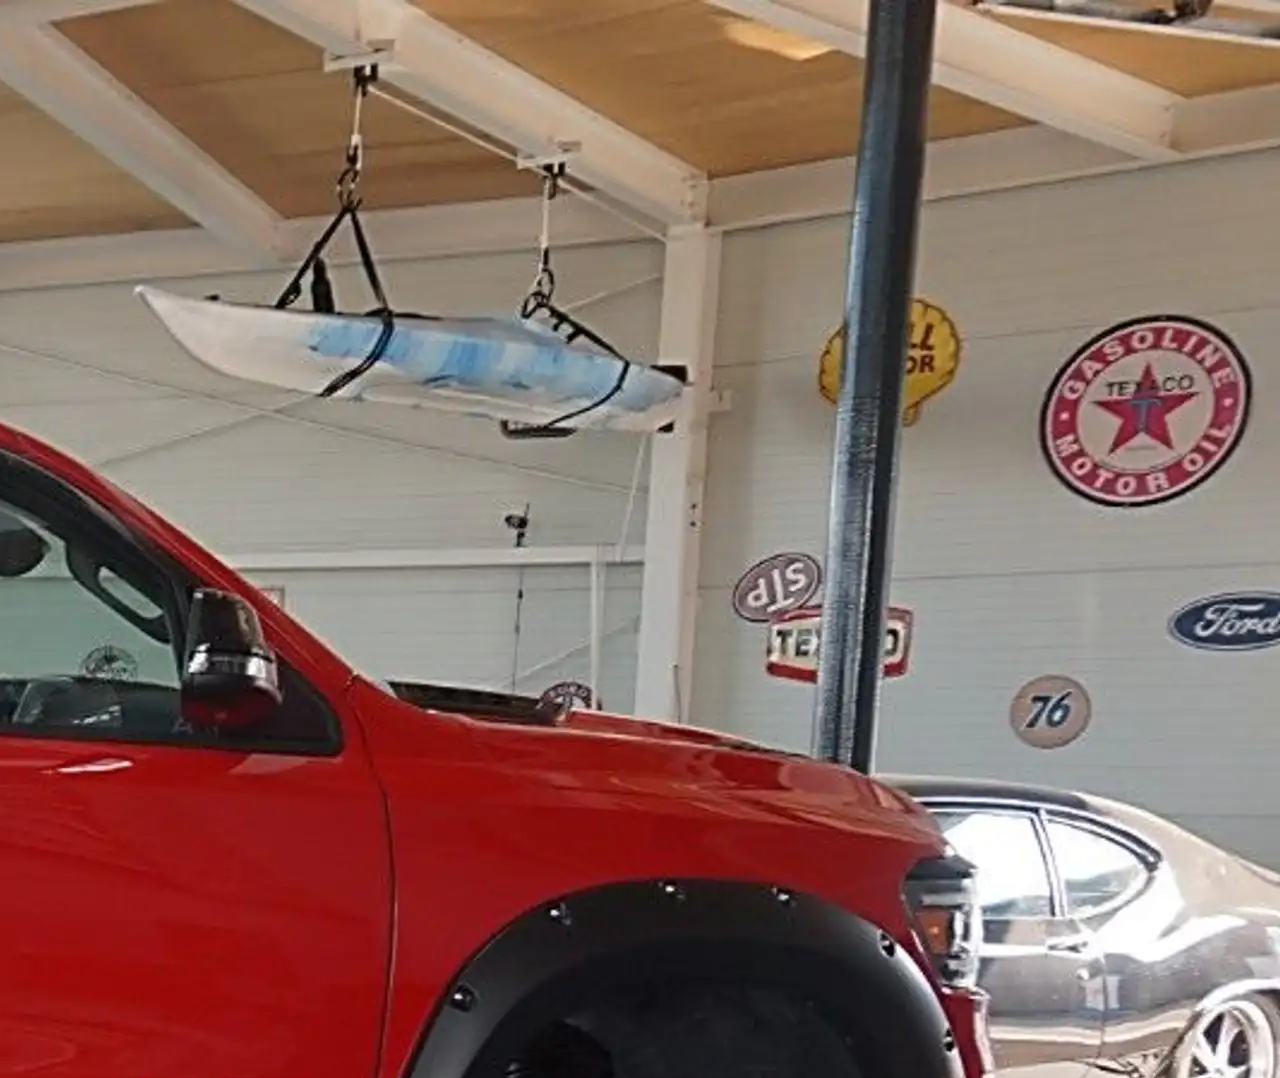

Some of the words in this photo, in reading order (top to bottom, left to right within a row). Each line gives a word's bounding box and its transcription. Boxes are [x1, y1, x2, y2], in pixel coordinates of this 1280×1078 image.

[1062, 328, 1235, 400] GASOLINE
[1054, 434, 1170, 495] MOTOR
[1182, 423, 1233, 472] OIL
[746, 561, 807, 613] STP
[1194, 602, 1280, 637] Ford
[1025, 691, 1072, 729] 76
